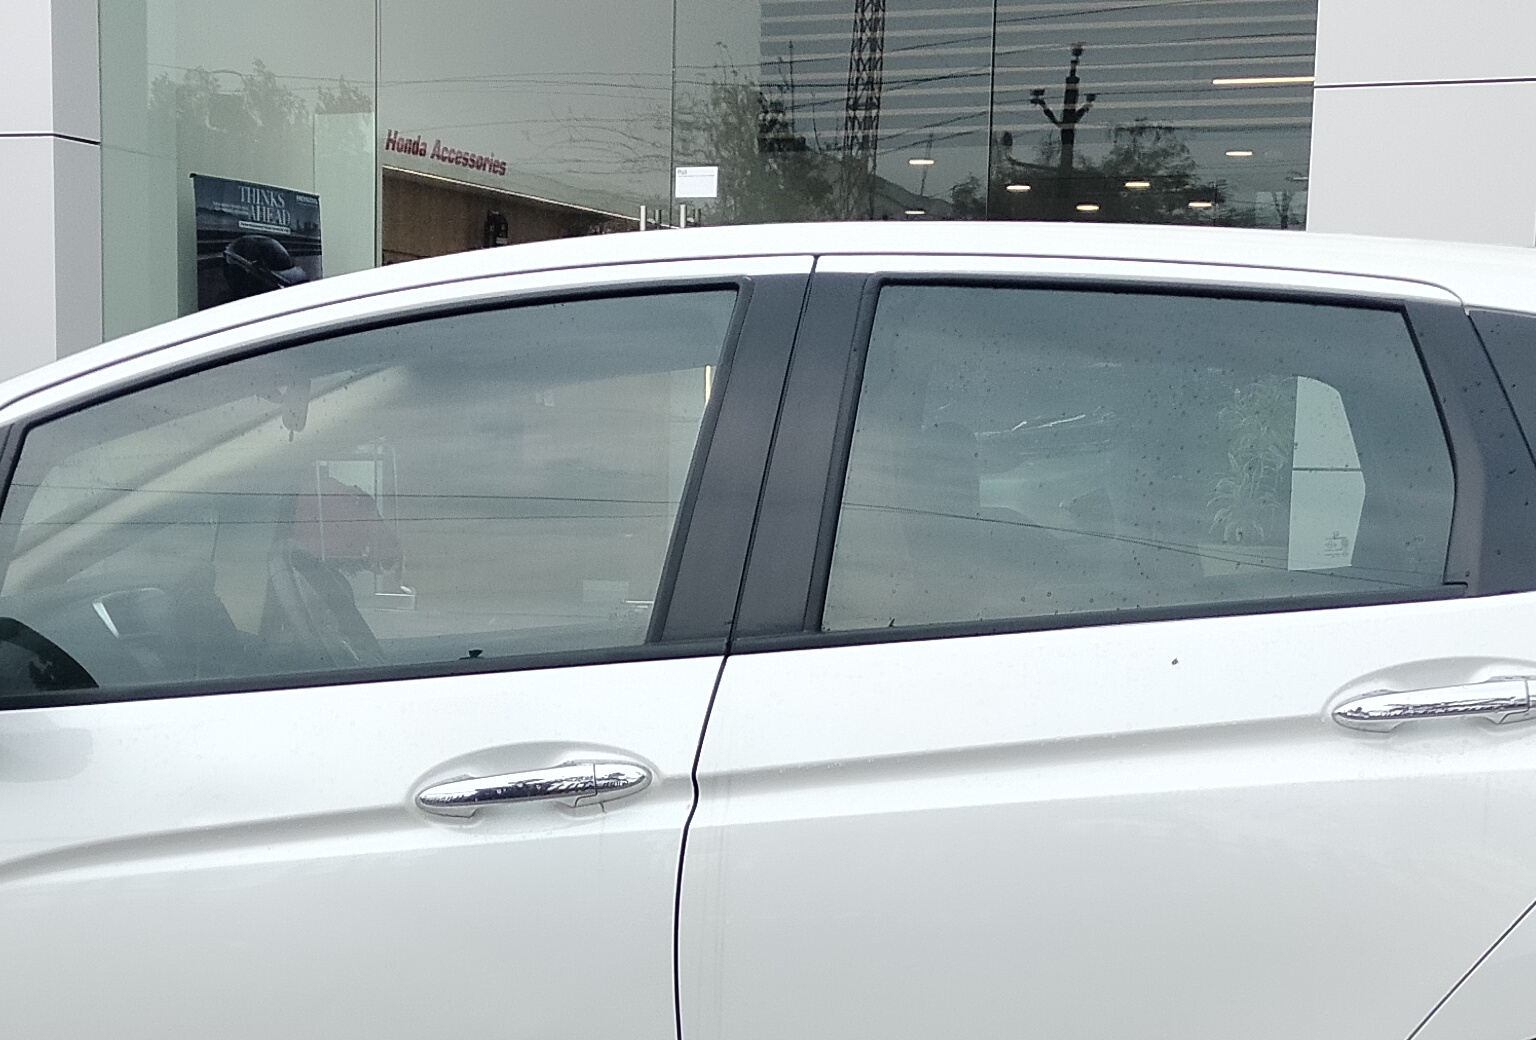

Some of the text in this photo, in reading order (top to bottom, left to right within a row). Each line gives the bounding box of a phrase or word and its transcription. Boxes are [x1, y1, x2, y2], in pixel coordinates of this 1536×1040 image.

[385, 129, 507, 176] Honda Accessories
[238, 185, 286, 208] THINKS
[248, 204, 291, 227] AHEAD
